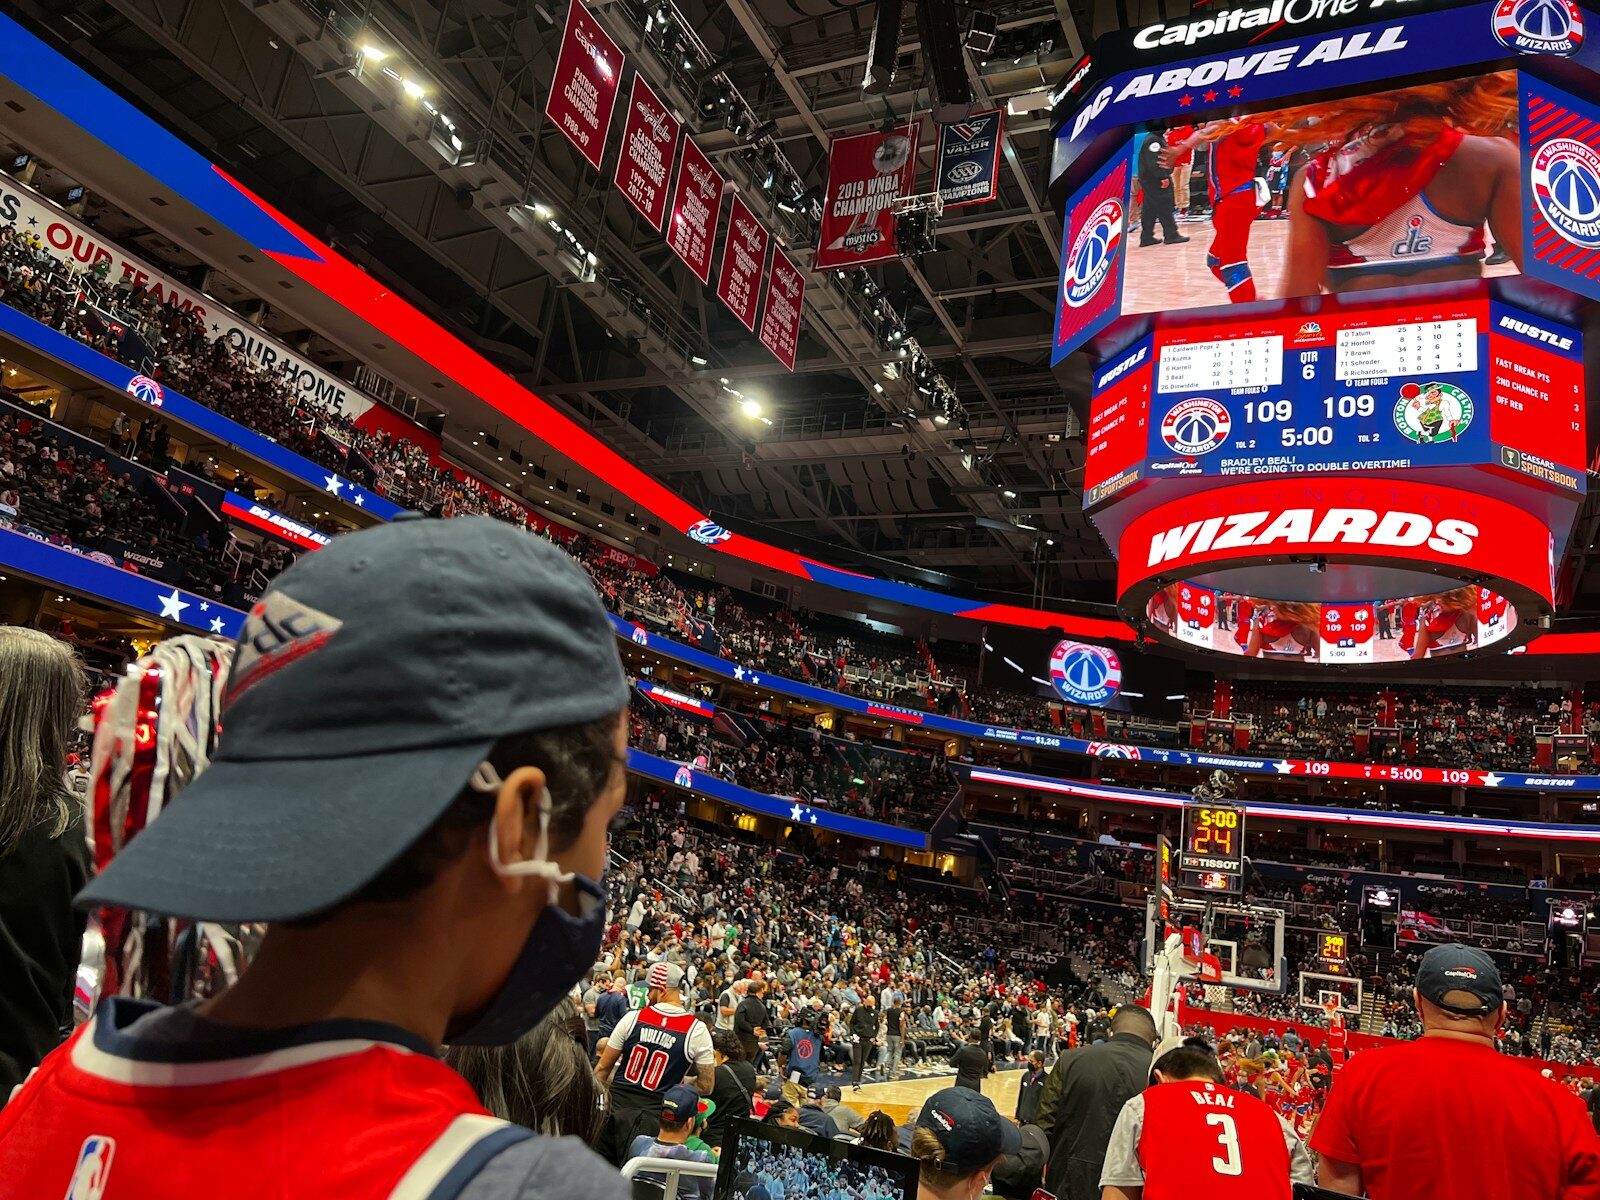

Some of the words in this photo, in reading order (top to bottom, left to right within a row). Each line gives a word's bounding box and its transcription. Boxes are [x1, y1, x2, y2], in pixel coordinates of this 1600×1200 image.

[1515, 36, 1572, 50] WIZARDS
[574, 67, 599, 103] PATRICK
[1070, 86, 1113, 142] DC
[1113, 46, 1300, 103] ABOVE
[1297, 26, 1408, 67] ALL
[571, 78, 598, 114] DIVISION
[564, 85, 599, 130] CHAMPIONS
[564, 113, 589, 146] 1988-89
[637, 128, 662, 162] EASTERN
[946, 141, 989, 154] VALOR
[630, 132, 666, 179] CONFERENCE
[629, 145, 662, 187] CHAMPIONS
[631, 169, 655, 200] 1997-98
[837, 181, 864, 200] 2019
[867, 174, 899, 195] WNBA
[940, 186, 990, 200] HAMPIONS
[952, 185, 971, 193] ARENA
[973, 181, 990, 189] BOWL
[628, 181, 652, 213] 2017-18
[833, 190, 899, 217] CHAMPIONS
[682, 205, 706, 239] CHAMPIONS
[1071, 258, 1109, 297] WIZARDS
[47, 223, 113, 268] OUR
[227, 328, 277, 366] OUR
[284, 358, 345, 409] HOME
[1499, 316, 1573, 350] HUSTLE
[1098, 346, 1147, 389] HUSTLE
[1300, 351, 1318, 364] QTR
[1351, 359, 1380, 367] Schroder
[1302, 364, 1315, 380] 6
[1345, 379, 1353, 387] 0
[1354, 378, 1370, 386] TEAM
[1371, 377, 1388, 386] FOULS
[1350, 368, 1387, 376] Richardson
[1496, 357, 1513, 369] FAST
[1514, 363, 1537, 379] BREAK
[1537, 372, 1551, 384] PTS
[1573, 385, 1579, 393] 5
[1231, 387, 1244, 395] TEAM
[1245, 386, 1260, 394] FOULS
[1261, 385, 1268, 393] 0
[1496, 376, 1511, 388] 2ND
[1512, 382, 1539, 398] CHANCE
[1540, 392, 1549, 401] FG
[1574, 404, 1579, 412] 3
[1170, 400, 1223, 417] WASHINGTON
[1244, 400, 1292, 424] 109
[1323, 394, 1375, 419] 109
[1396, 398, 1413, 435] BOSTON
[1451, 389, 1471, 425] CELTICS
[1496, 395, 1509, 405] OFF
[1509, 400, 1524, 411] REB
[1571, 421, 1580, 431] 12
[1235, 441, 1247, 449] TOL
[1249, 440, 1255, 448] 2
[1281, 426, 1333, 446] 5:00
[1358, 434, 1370, 442] TOL
[1372, 433, 1380, 442] 2
[1174, 440, 1216, 453] WIZARDS
[1220, 466, 1251, 475] WE'RE
[1253, 465, 1288, 474] GOING
[1290, 464, 1304, 472] TO
[1307, 462, 1349, 472] DOUBLE
[1352, 459, 1411, 470] OVERTIME!
[1221, 458, 1265, 467] BRADLEY
[1267, 456, 1296, 465] BEAL!
[1521, 453, 1555, 469] CAESARS
[1100, 470, 1139, 498] SPORTSBOOK
[1101, 471, 1124, 488] CAESARS
[1521, 461, 1577, 490] SPORTSBOOK
[268, 515, 313, 538] ABOVE
[1147, 508, 1479, 567] WIZARDS
[123, 550, 165, 569] wizards
[610, 549, 629, 565] REP
[1181, 602, 1192, 611] 109
[1197, 606, 1209, 616] 109
[1481, 600, 1492, 612] 109
[1182, 629, 1194, 637] 5:00
[1326, 623, 1342, 632] 109
[1350, 623, 1366, 631] 109
[1483, 629, 1494, 639] 5:00
[1062, 681, 1108, 701] WIZARDS
[1035, 737, 1060, 747] $1,245
[1198, 756, 1264, 769] WASHINGTON
[1305, 763, 1329, 774] 109
[1390, 769, 1423, 781] 5:00
[1442, 771, 1470, 783] 109
[1525, 777, 1576, 786] BOSTON
[1201, 810, 1237, 828] 5:00
[1194, 827, 1231, 854] 24
[1200, 859, 1239, 870] TISSOT
[1010, 950, 1058, 965] ETIHAD
[1323, 943, 1341, 957] 24
[1444, 970, 1477, 980] CapitalOne
[624, 1043, 669, 1091] 00
[1190, 1090, 1235, 1109] BEAL
[1206, 1112, 1242, 1176] 3
